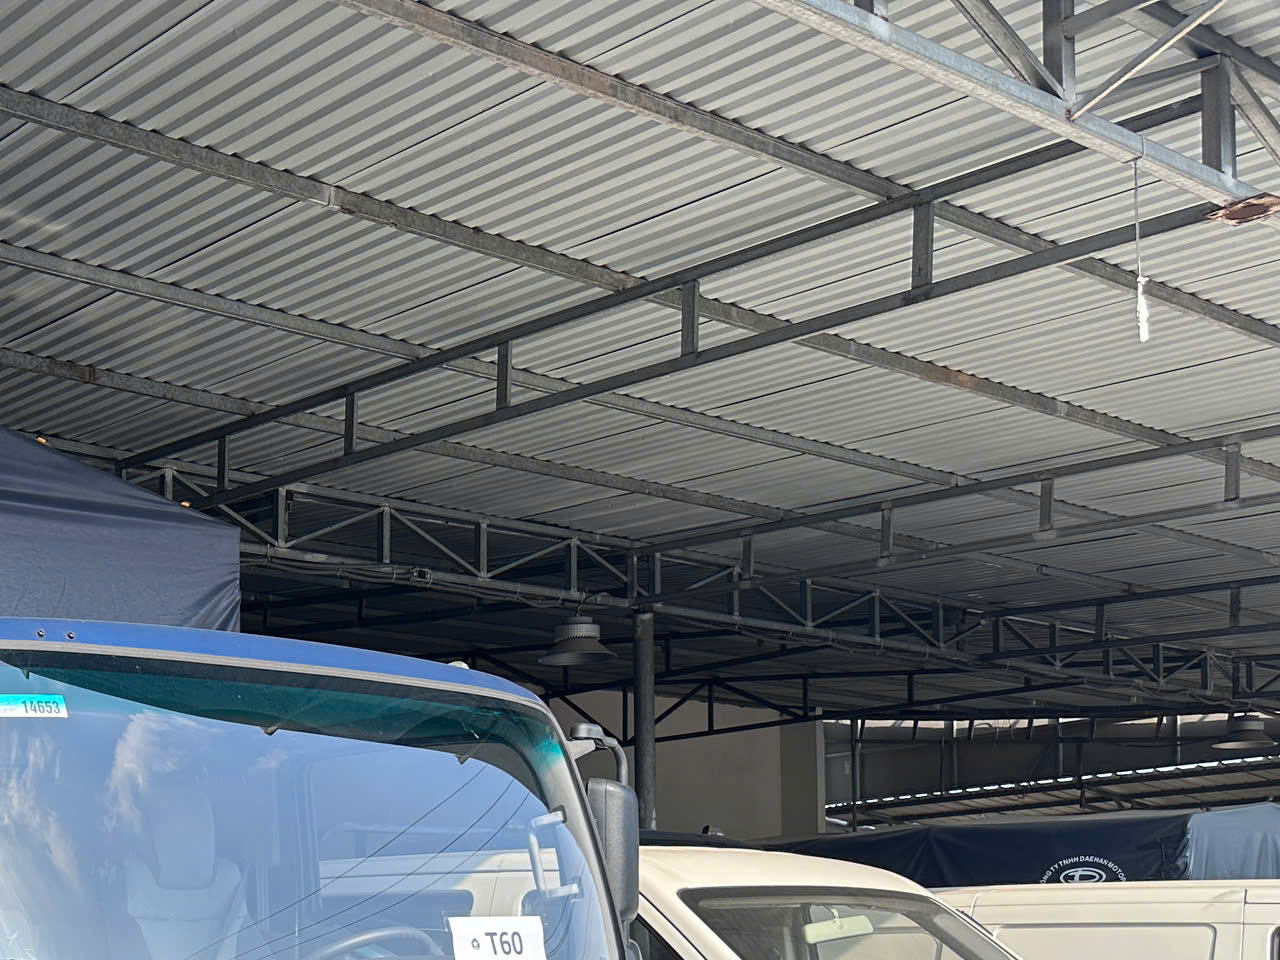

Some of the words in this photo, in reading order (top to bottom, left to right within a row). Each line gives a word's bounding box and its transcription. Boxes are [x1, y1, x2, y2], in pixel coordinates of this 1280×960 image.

[21, 699, 61, 714] 14653
[1049, 863, 1060, 872] TY
[1058, 856, 1079, 867] TNHH
[1079, 855, 1109, 866] DAEHAN
[484, 931, 524, 955] T60
